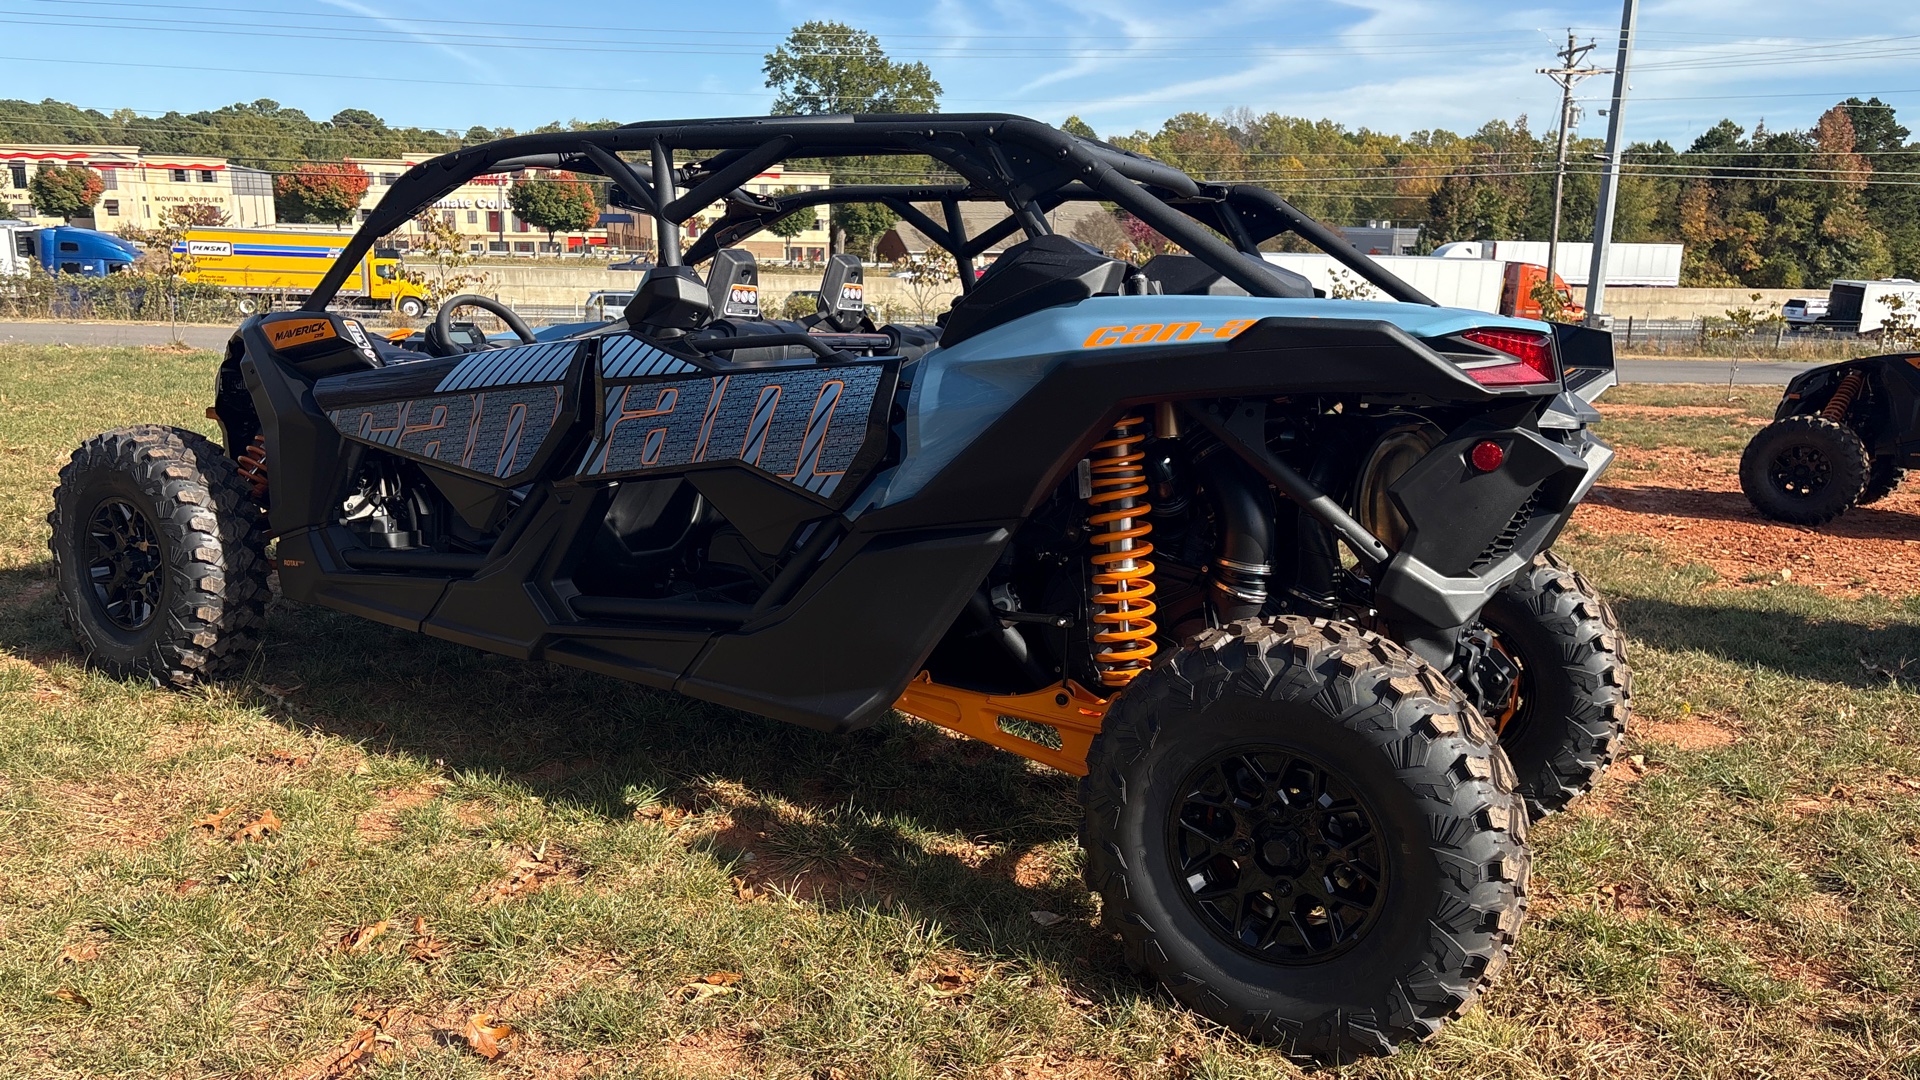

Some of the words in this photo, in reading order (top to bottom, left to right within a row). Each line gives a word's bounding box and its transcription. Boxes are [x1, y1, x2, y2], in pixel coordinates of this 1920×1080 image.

[431, 199, 472, 209] imate
[275, 321, 326, 341] MAVERICK
[283, 559, 299, 567] ROTAX
